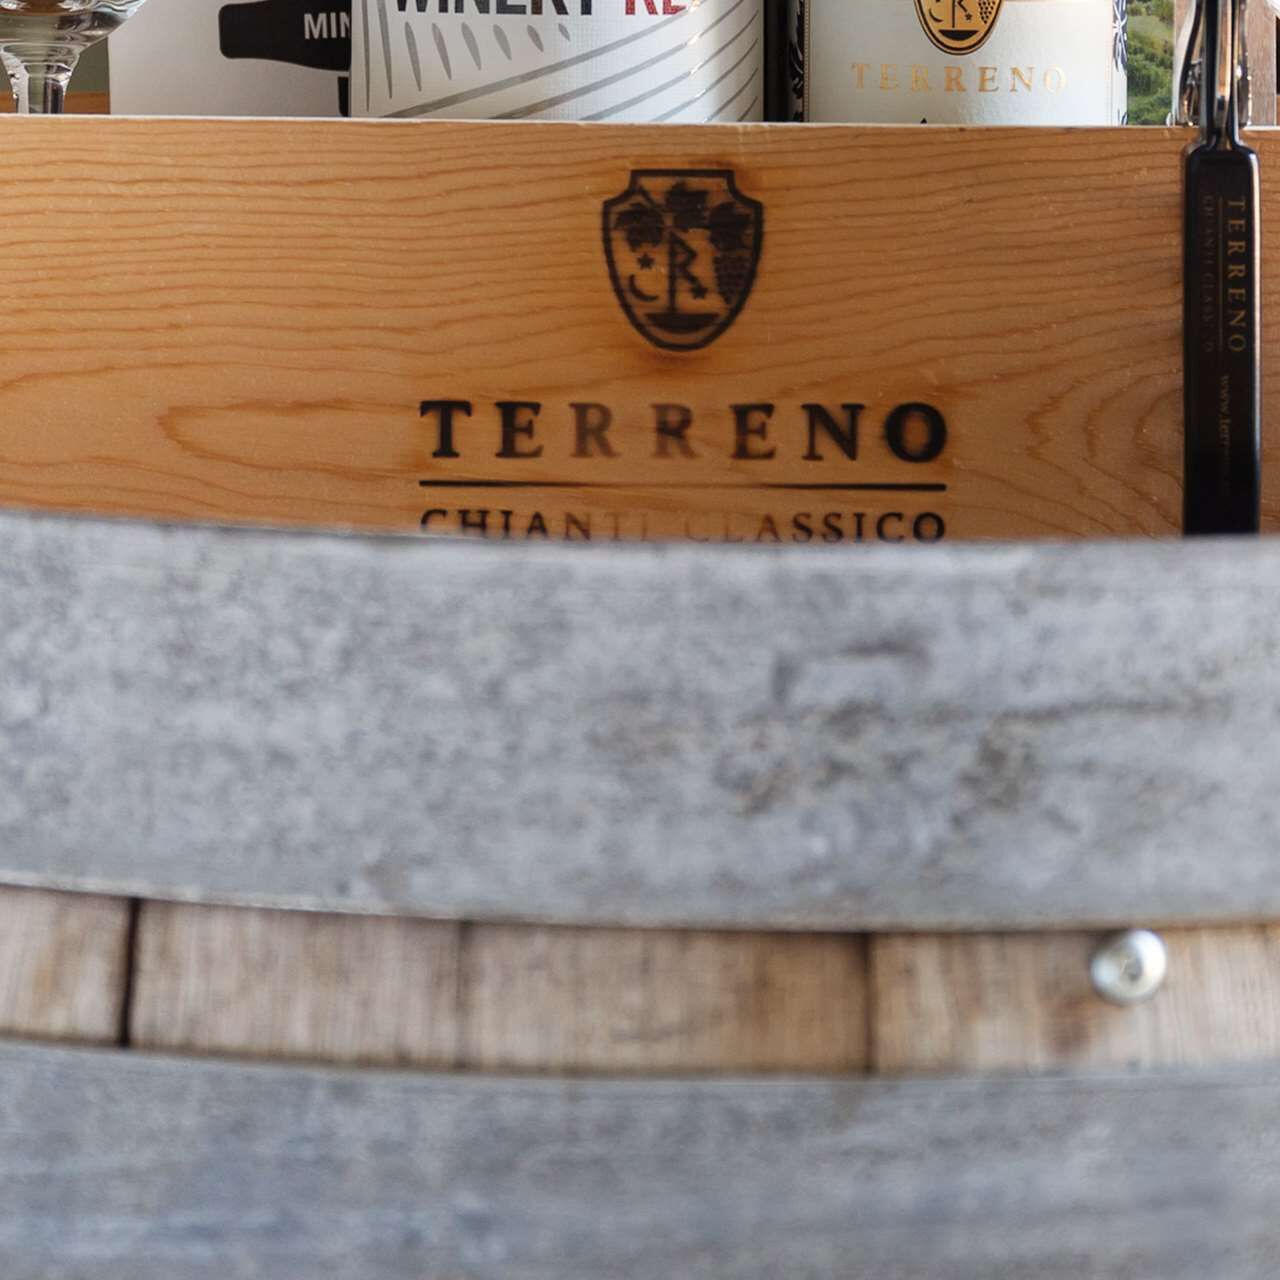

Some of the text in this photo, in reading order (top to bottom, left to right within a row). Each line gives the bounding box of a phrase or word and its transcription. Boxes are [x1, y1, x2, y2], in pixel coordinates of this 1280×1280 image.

[851, 62, 1067, 94] TERRENO
[1227, 196, 1246, 353] TERRENO
[1201, 271, 1216, 353] CLASSO
[419, 399, 949, 463] TERRENO
[419, 508, 947, 544] CHIANTI CLASSICO
